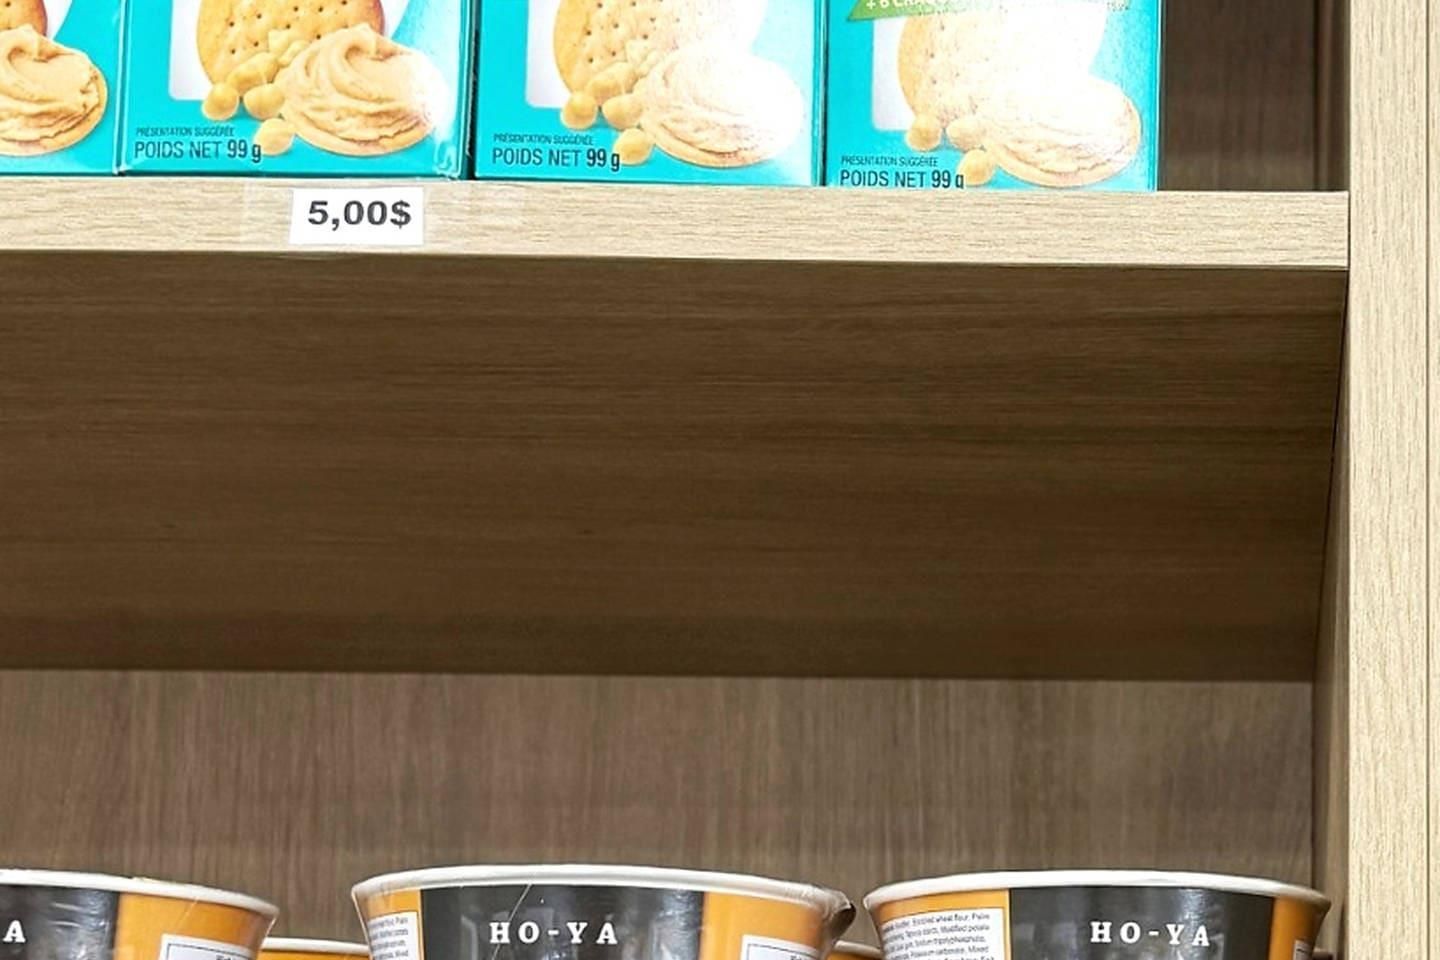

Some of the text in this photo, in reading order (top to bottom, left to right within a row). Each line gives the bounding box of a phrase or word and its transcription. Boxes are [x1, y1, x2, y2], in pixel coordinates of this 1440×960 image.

[134, 140, 262, 163] POIDS NET 99 g
[492, 148, 620, 172] POIDS NET 99 g
[840, 169, 889, 187] POIDS
[895, 171, 927, 188] NET
[931, 170, 950, 188] 99
[308, 200, 412, 231] 5,00$
[1090, 921, 1210, 947] HO-YA
